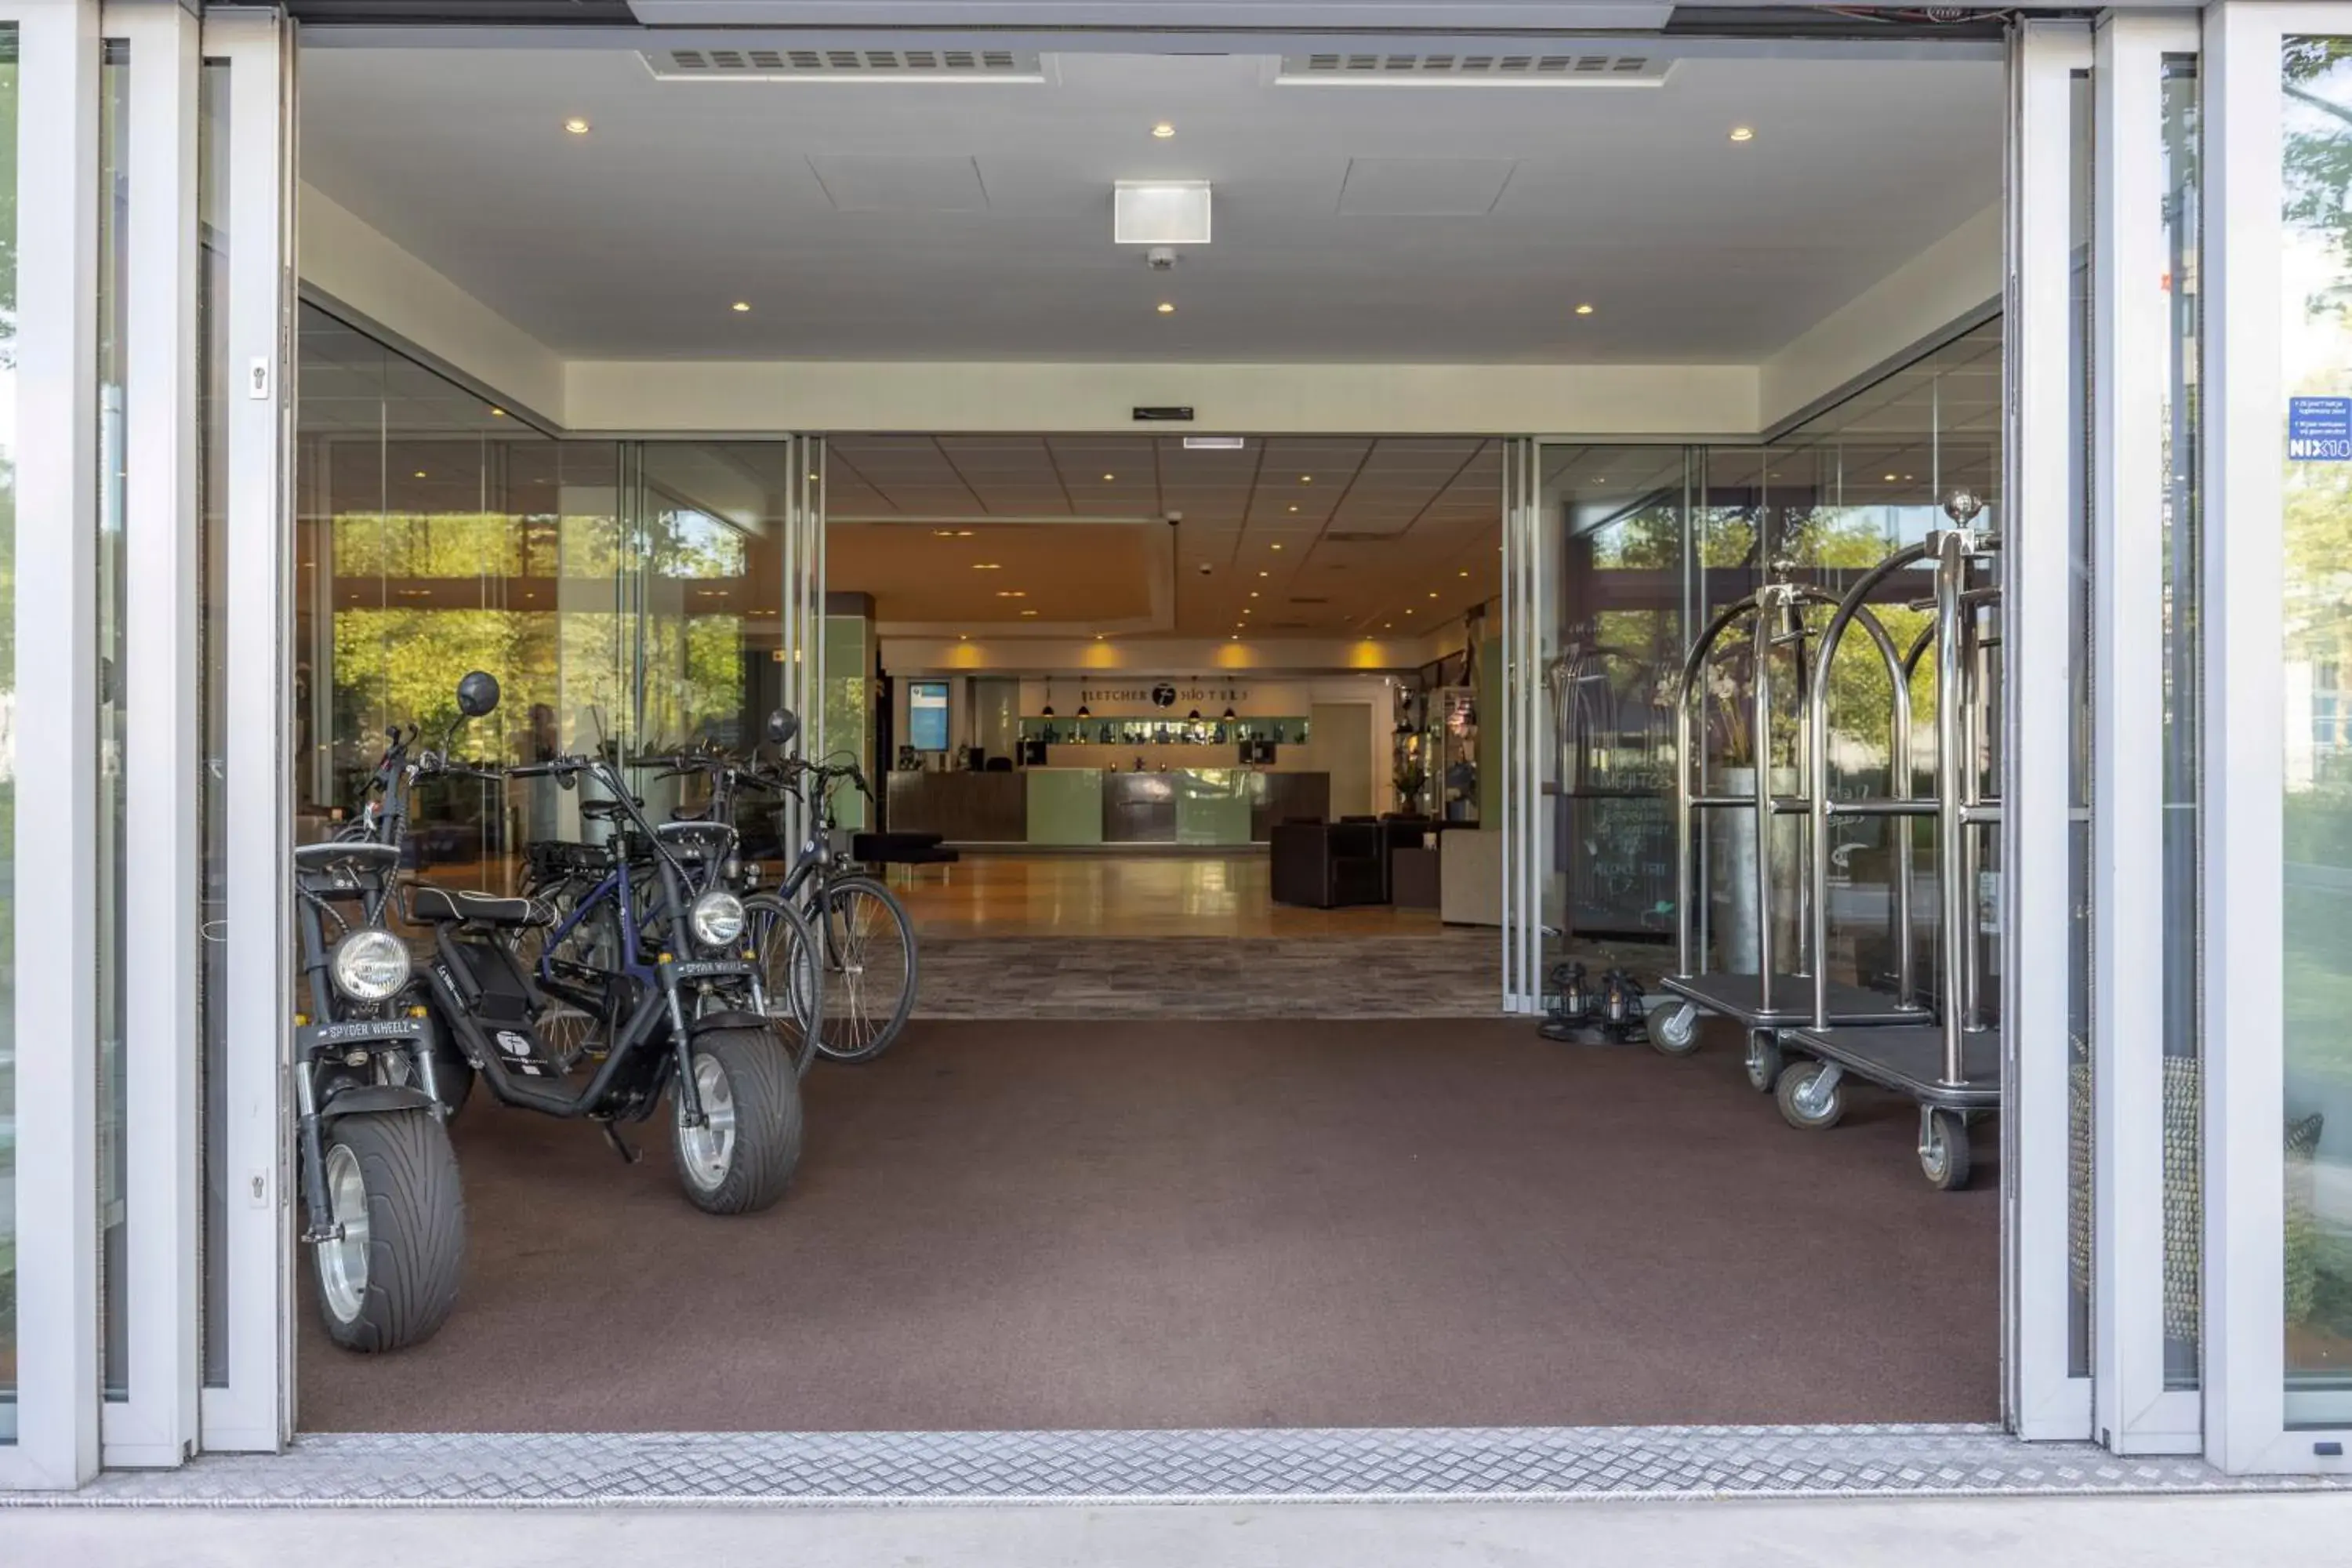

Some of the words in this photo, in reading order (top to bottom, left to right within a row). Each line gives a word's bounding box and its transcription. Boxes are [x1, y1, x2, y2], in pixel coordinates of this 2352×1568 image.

[2291, 439, 2350, 457] NIX18
[329, 1023, 368, 1038] SPYDER
[372, 1021, 410, 1036] WHEELZ
